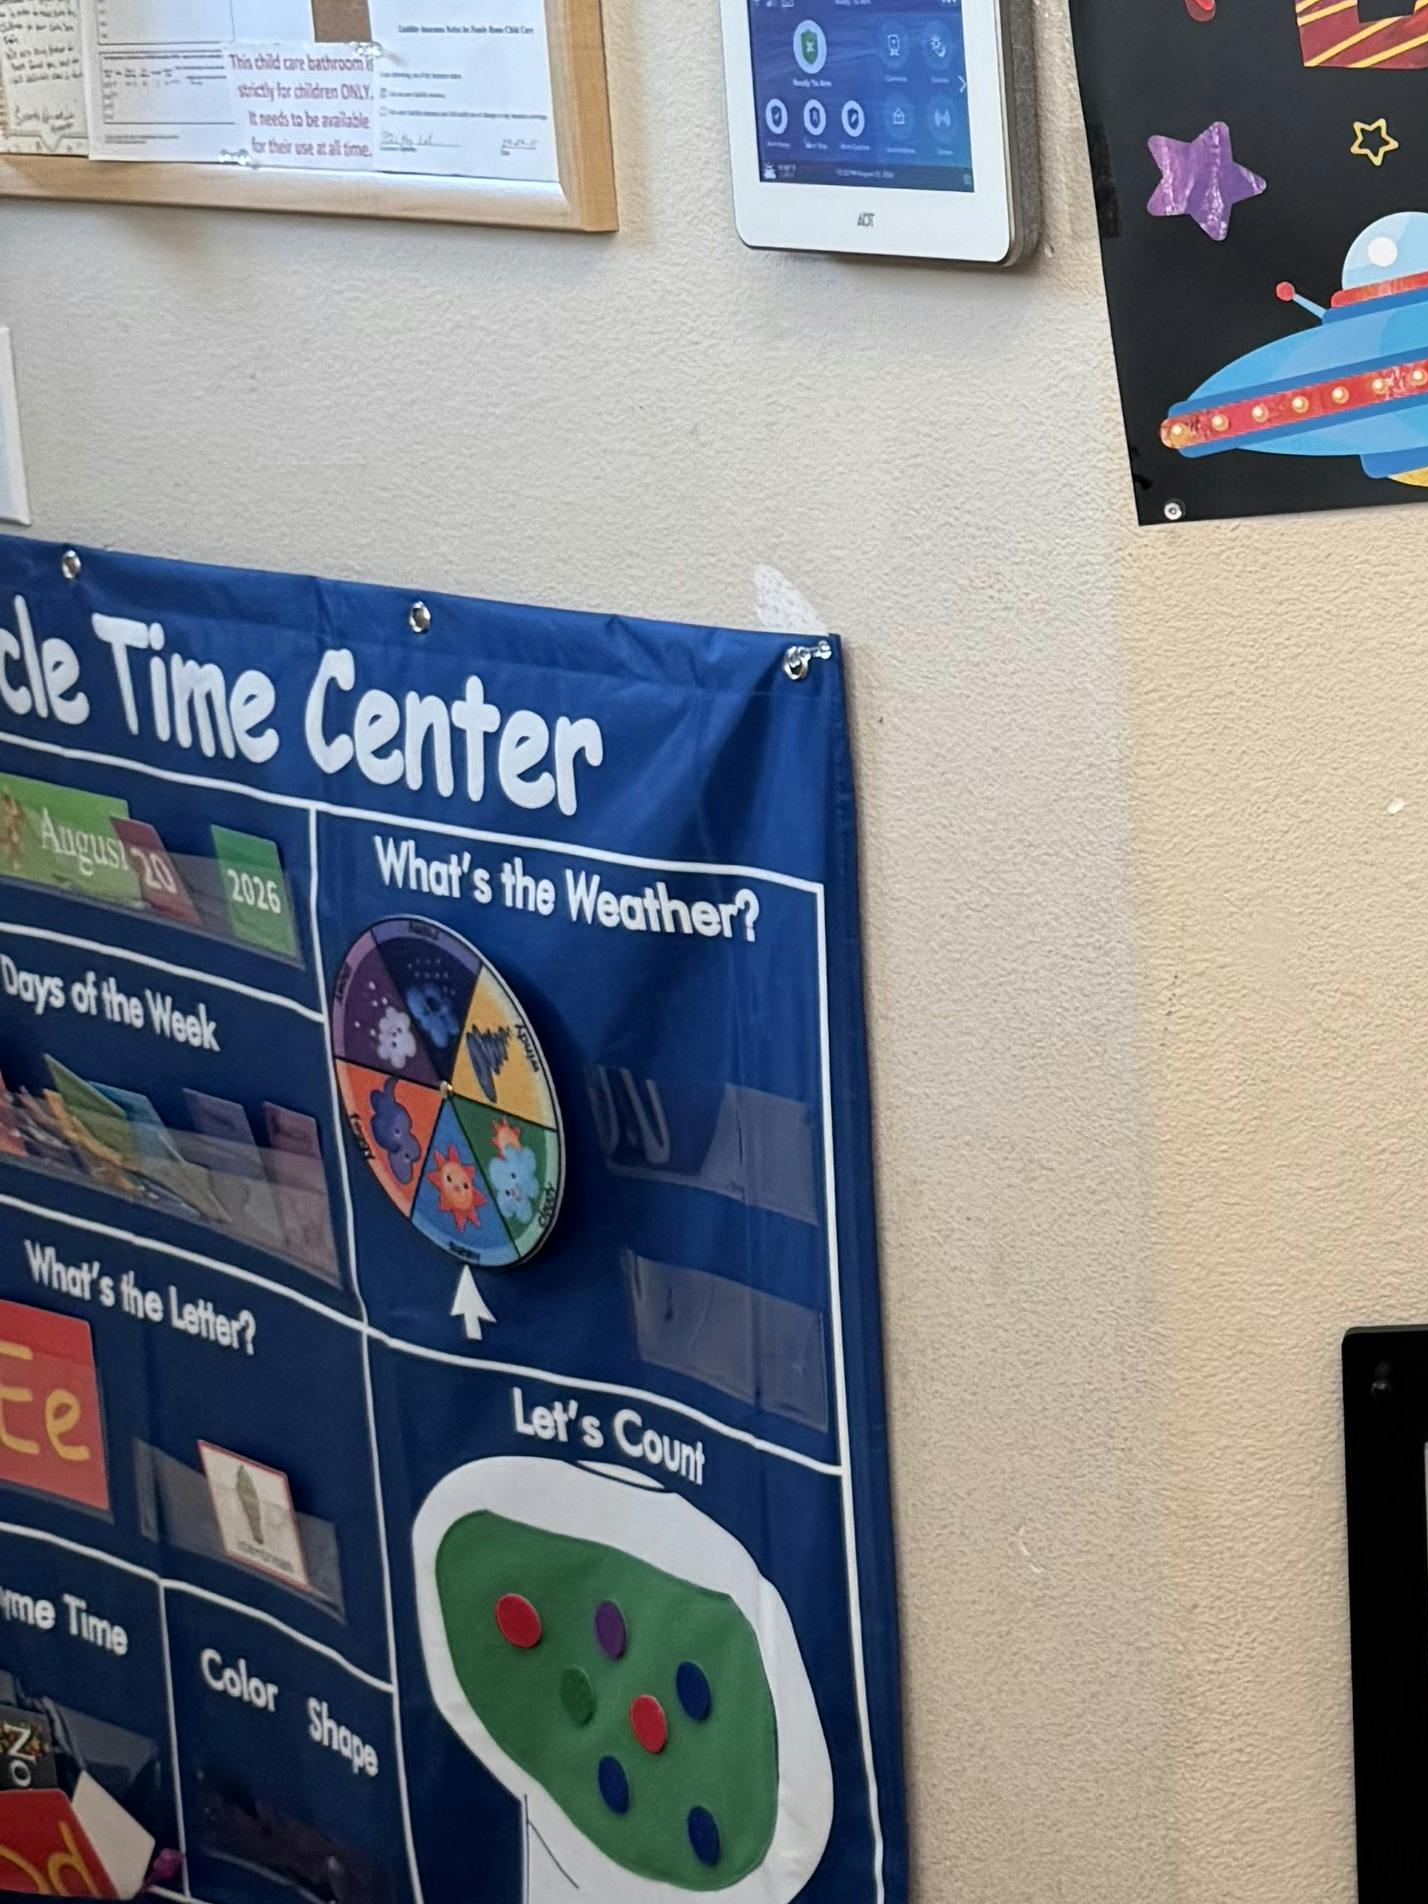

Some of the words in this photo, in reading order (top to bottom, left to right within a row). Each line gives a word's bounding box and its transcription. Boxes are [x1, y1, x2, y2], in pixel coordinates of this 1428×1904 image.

[229, 54, 252, 70] This
[254, 53, 280, 70] child
[307, 54, 363, 71] bathroom
[238, 83, 274, 102] strictly
[276, 82, 291, 98] for
[294, 83, 338, 99] children
[251, 137, 266, 153] for
[268, 138, 292, 154] their
[295, 143, 314, 156] use
[259, 111, 289, 127] needs
[291, 113, 303, 127] to
[305, 110, 320, 128] be
[322, 111, 371, 129] available
[91, 612, 280, 764] Time
[305, 648, 603, 816] Center
[130, 847, 178, 894] 20
[227, 868, 282, 914] 2026
[373, 835, 493, 905] What's
[502, 856, 556, 916] the
[565, 869, 760, 943] Weather?
[0, 953, 66, 1015] Days
[71, 970, 97, 1016] of
[102, 976, 144, 1030] the
[145, 988, 221, 1053] Week
[24, 1238, 115, 1308] What's
[121, 1270, 164, 1323] the
[169, 1285, 257, 1356] Letter?
[513, 1386, 604, 1449] Let's
[614, 1408, 706, 1486] Count
[63, 1593, 128, 1656] Time
[200, 1648, 278, 1712] Color
[307, 1697, 379, 1777] Shape
